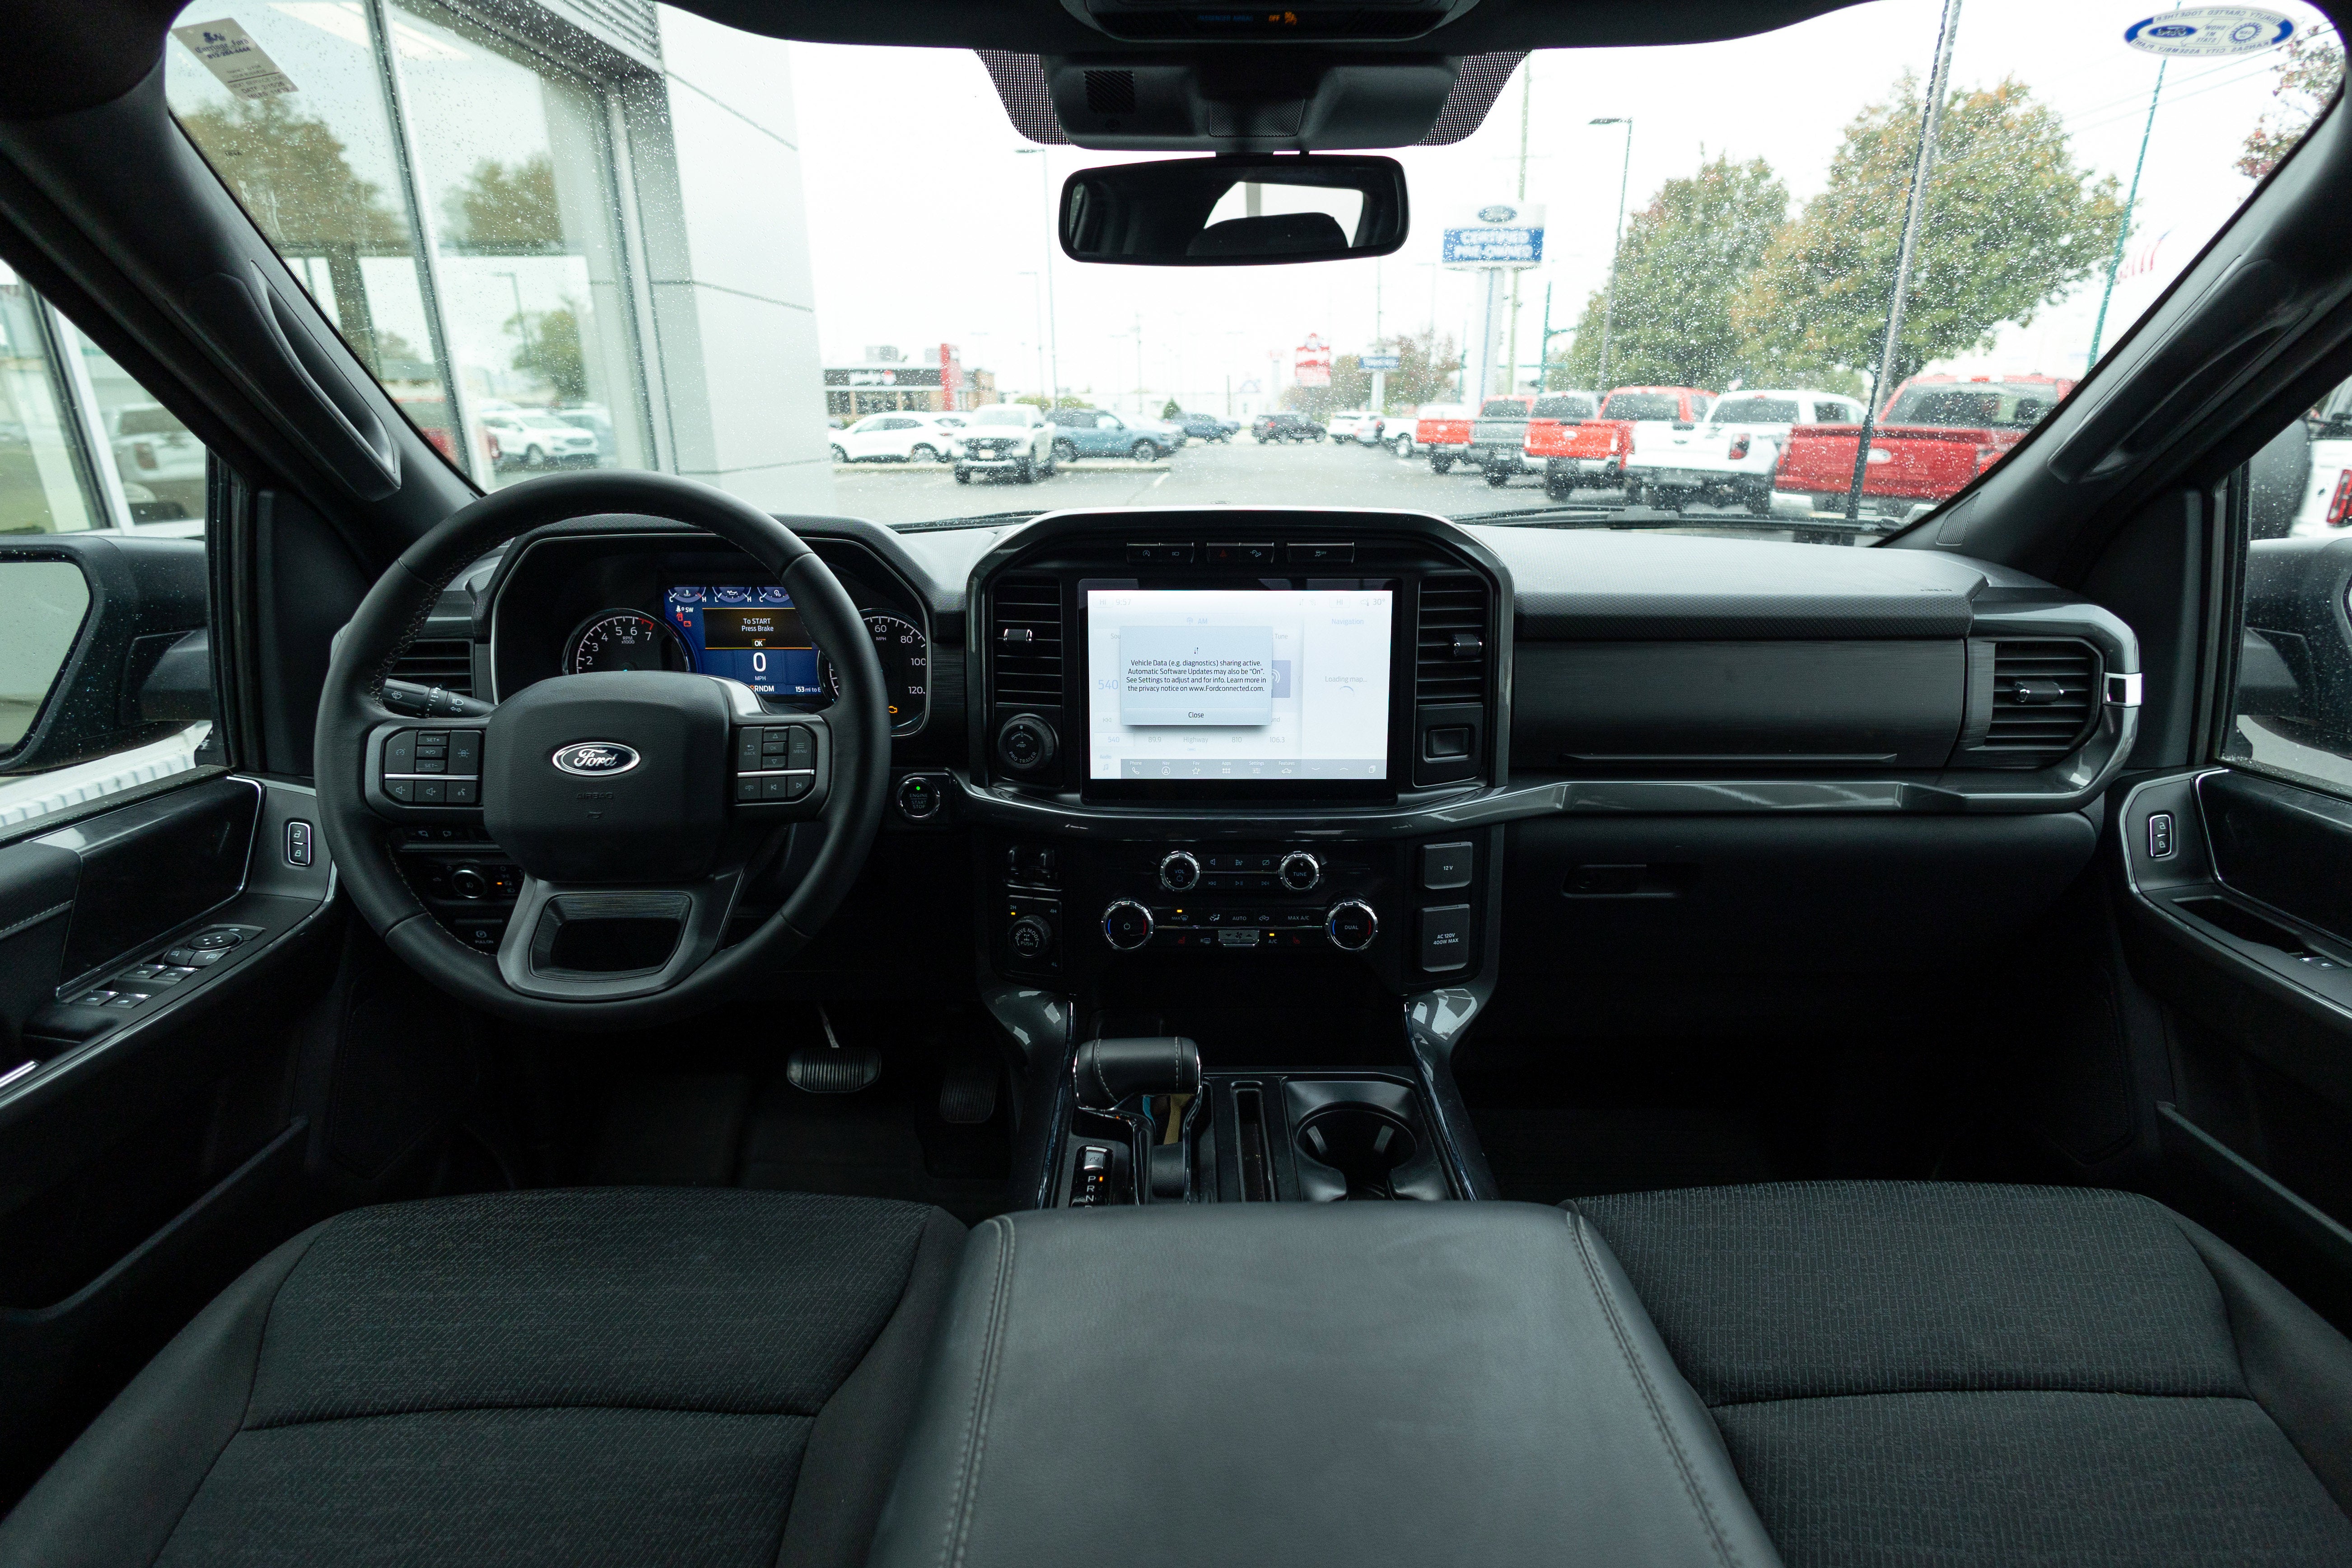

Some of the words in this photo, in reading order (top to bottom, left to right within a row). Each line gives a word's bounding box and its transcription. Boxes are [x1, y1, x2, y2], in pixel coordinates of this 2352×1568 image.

[1331, 617, 1364, 626] Navigation
[616, 627, 622, 635] 5
[630, 627, 637, 635] 6
[602, 633, 608, 641] 4
[645, 632, 651, 640] 7
[592, 643, 598, 651] 3
[586, 656, 593, 665] 2
[753, 652, 766, 672] 0
[1098, 679, 1118, 690] 540
[574, 748, 619, 767] Ford
[1009, 751, 1017, 761] PRO
[1019, 751, 1037, 763] TRAILER
[1015, 928, 1027, 940] DRIVE
[1027, 928, 1040, 942] MODE
